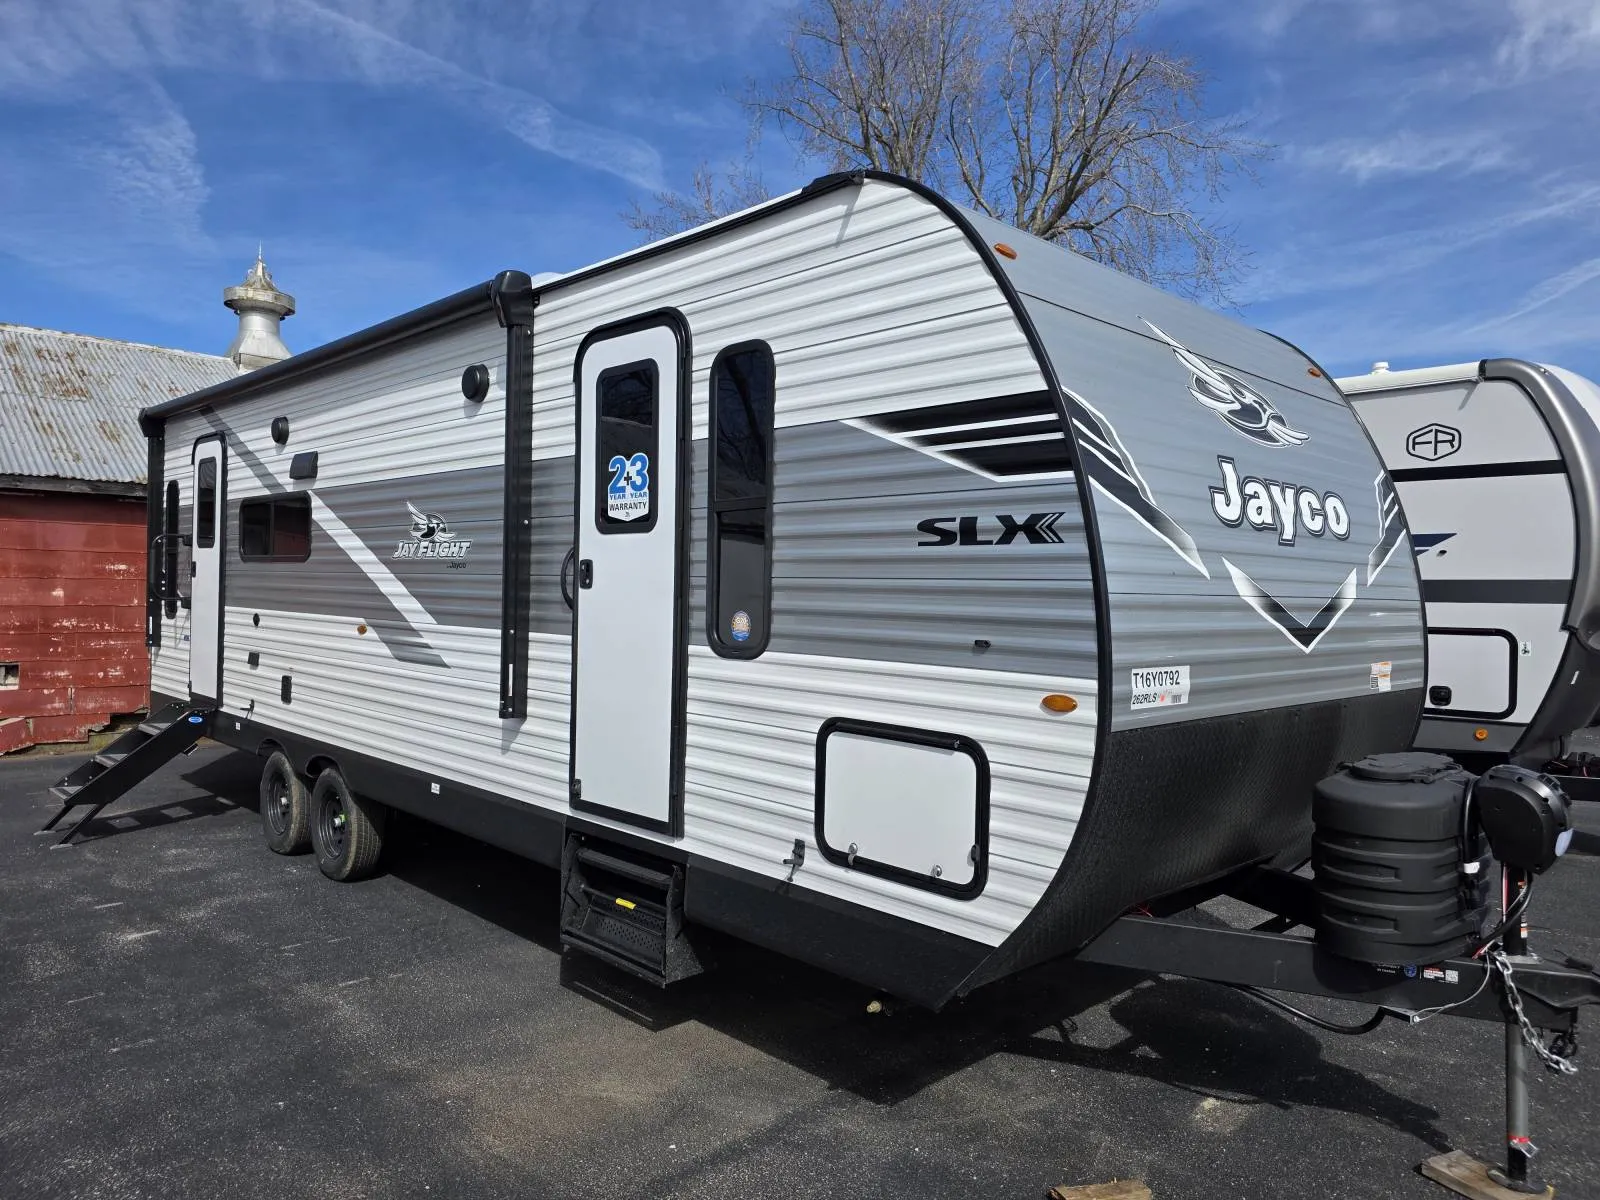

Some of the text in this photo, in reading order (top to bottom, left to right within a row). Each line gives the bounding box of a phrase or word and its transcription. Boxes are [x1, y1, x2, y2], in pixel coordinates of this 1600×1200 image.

[1412, 429, 1455, 456] FR
[609, 502, 647, 511] WARRANTY
[1208, 455, 1351, 547] Jayco
[917, 512, 1066, 546] SLX
[393, 540, 472, 558] JAY FLIGHT
[450, 562, 467, 570] Jayco
[1133, 670, 1180, 689] T16Y0792
[1132, 693, 1158, 705] 262RLS
